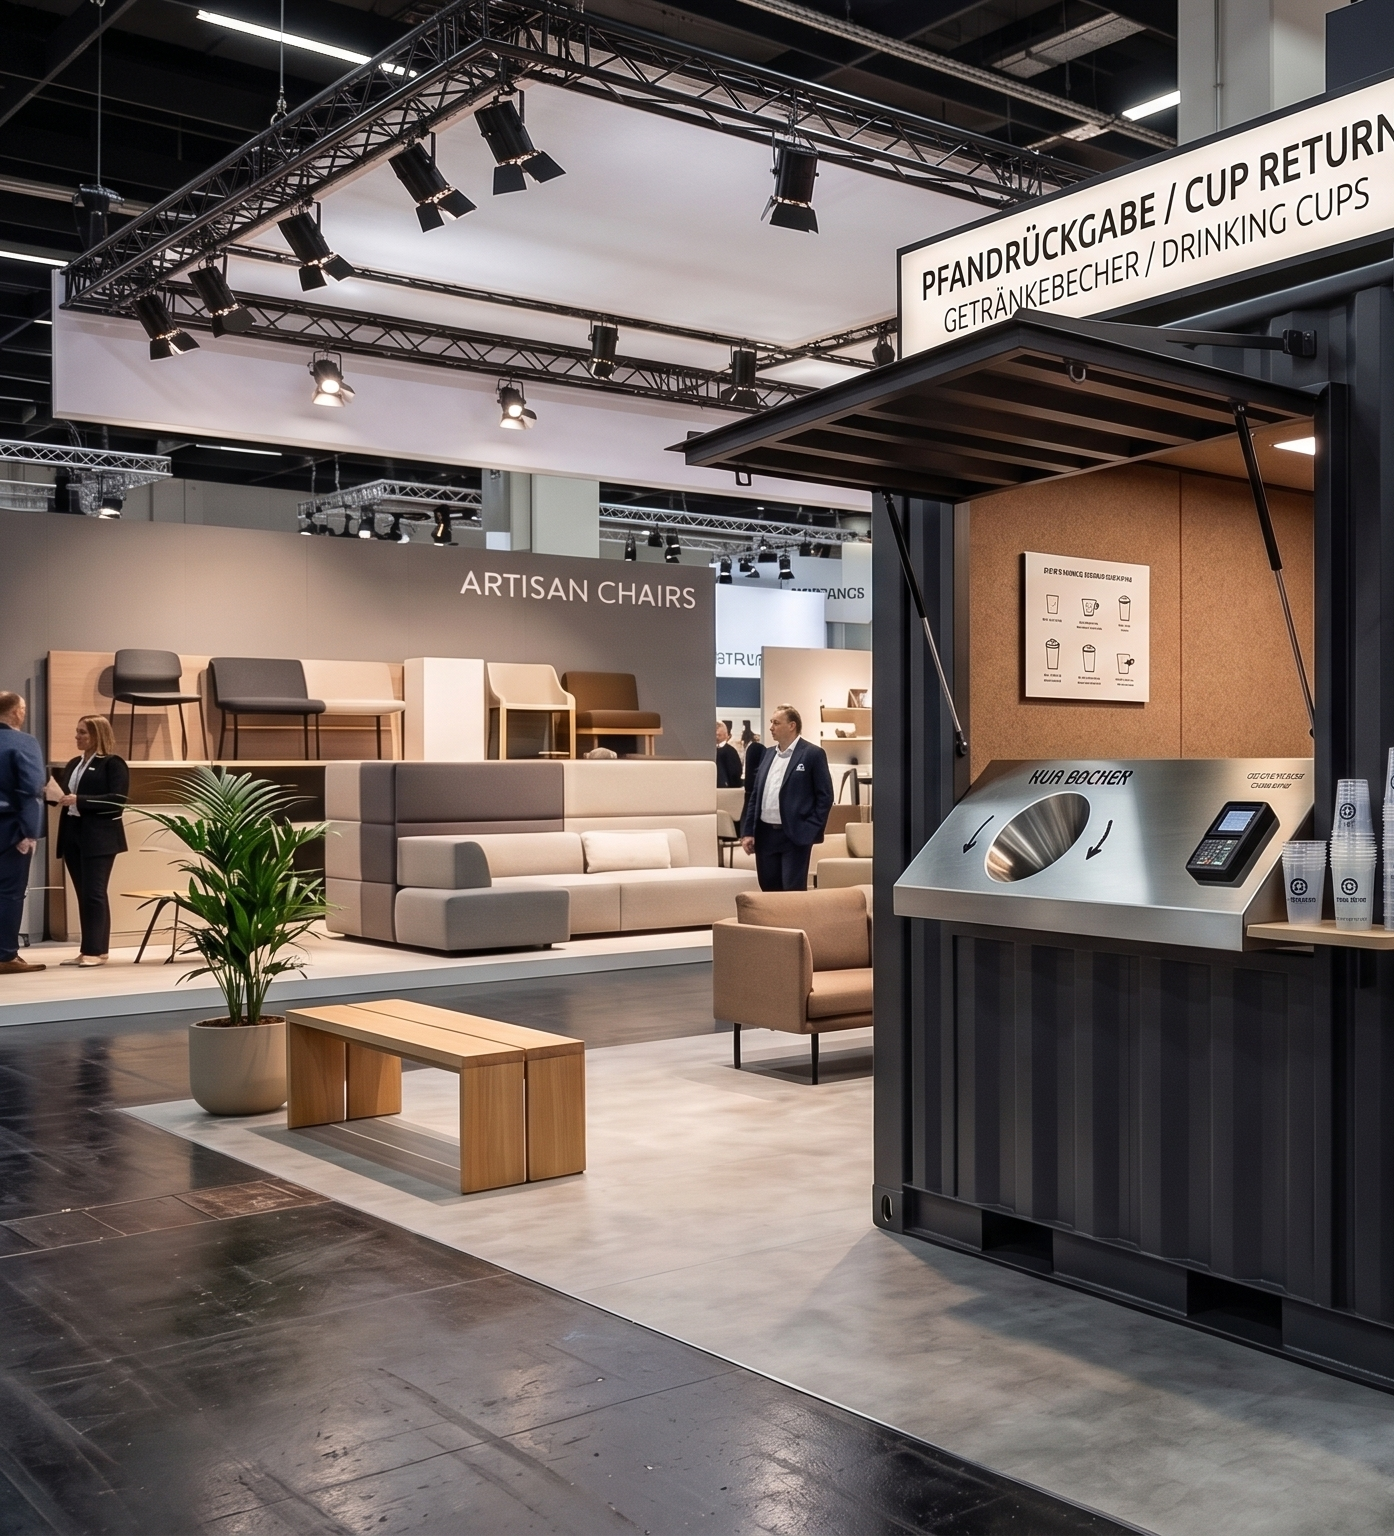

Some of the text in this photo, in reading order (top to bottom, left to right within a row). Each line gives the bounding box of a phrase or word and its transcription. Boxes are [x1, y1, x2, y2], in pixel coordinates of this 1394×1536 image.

[922, 192, 1156, 301] PFANDRÜCKGABE
[1164, 182, 1177, 226] /
[1185, 162, 1249, 214] CUP
[944, 176, 1370, 333] GETRÄNKEBECHER / DRINKING CUPS
[459, 570, 697, 610] ARTISAN CHAIRS
